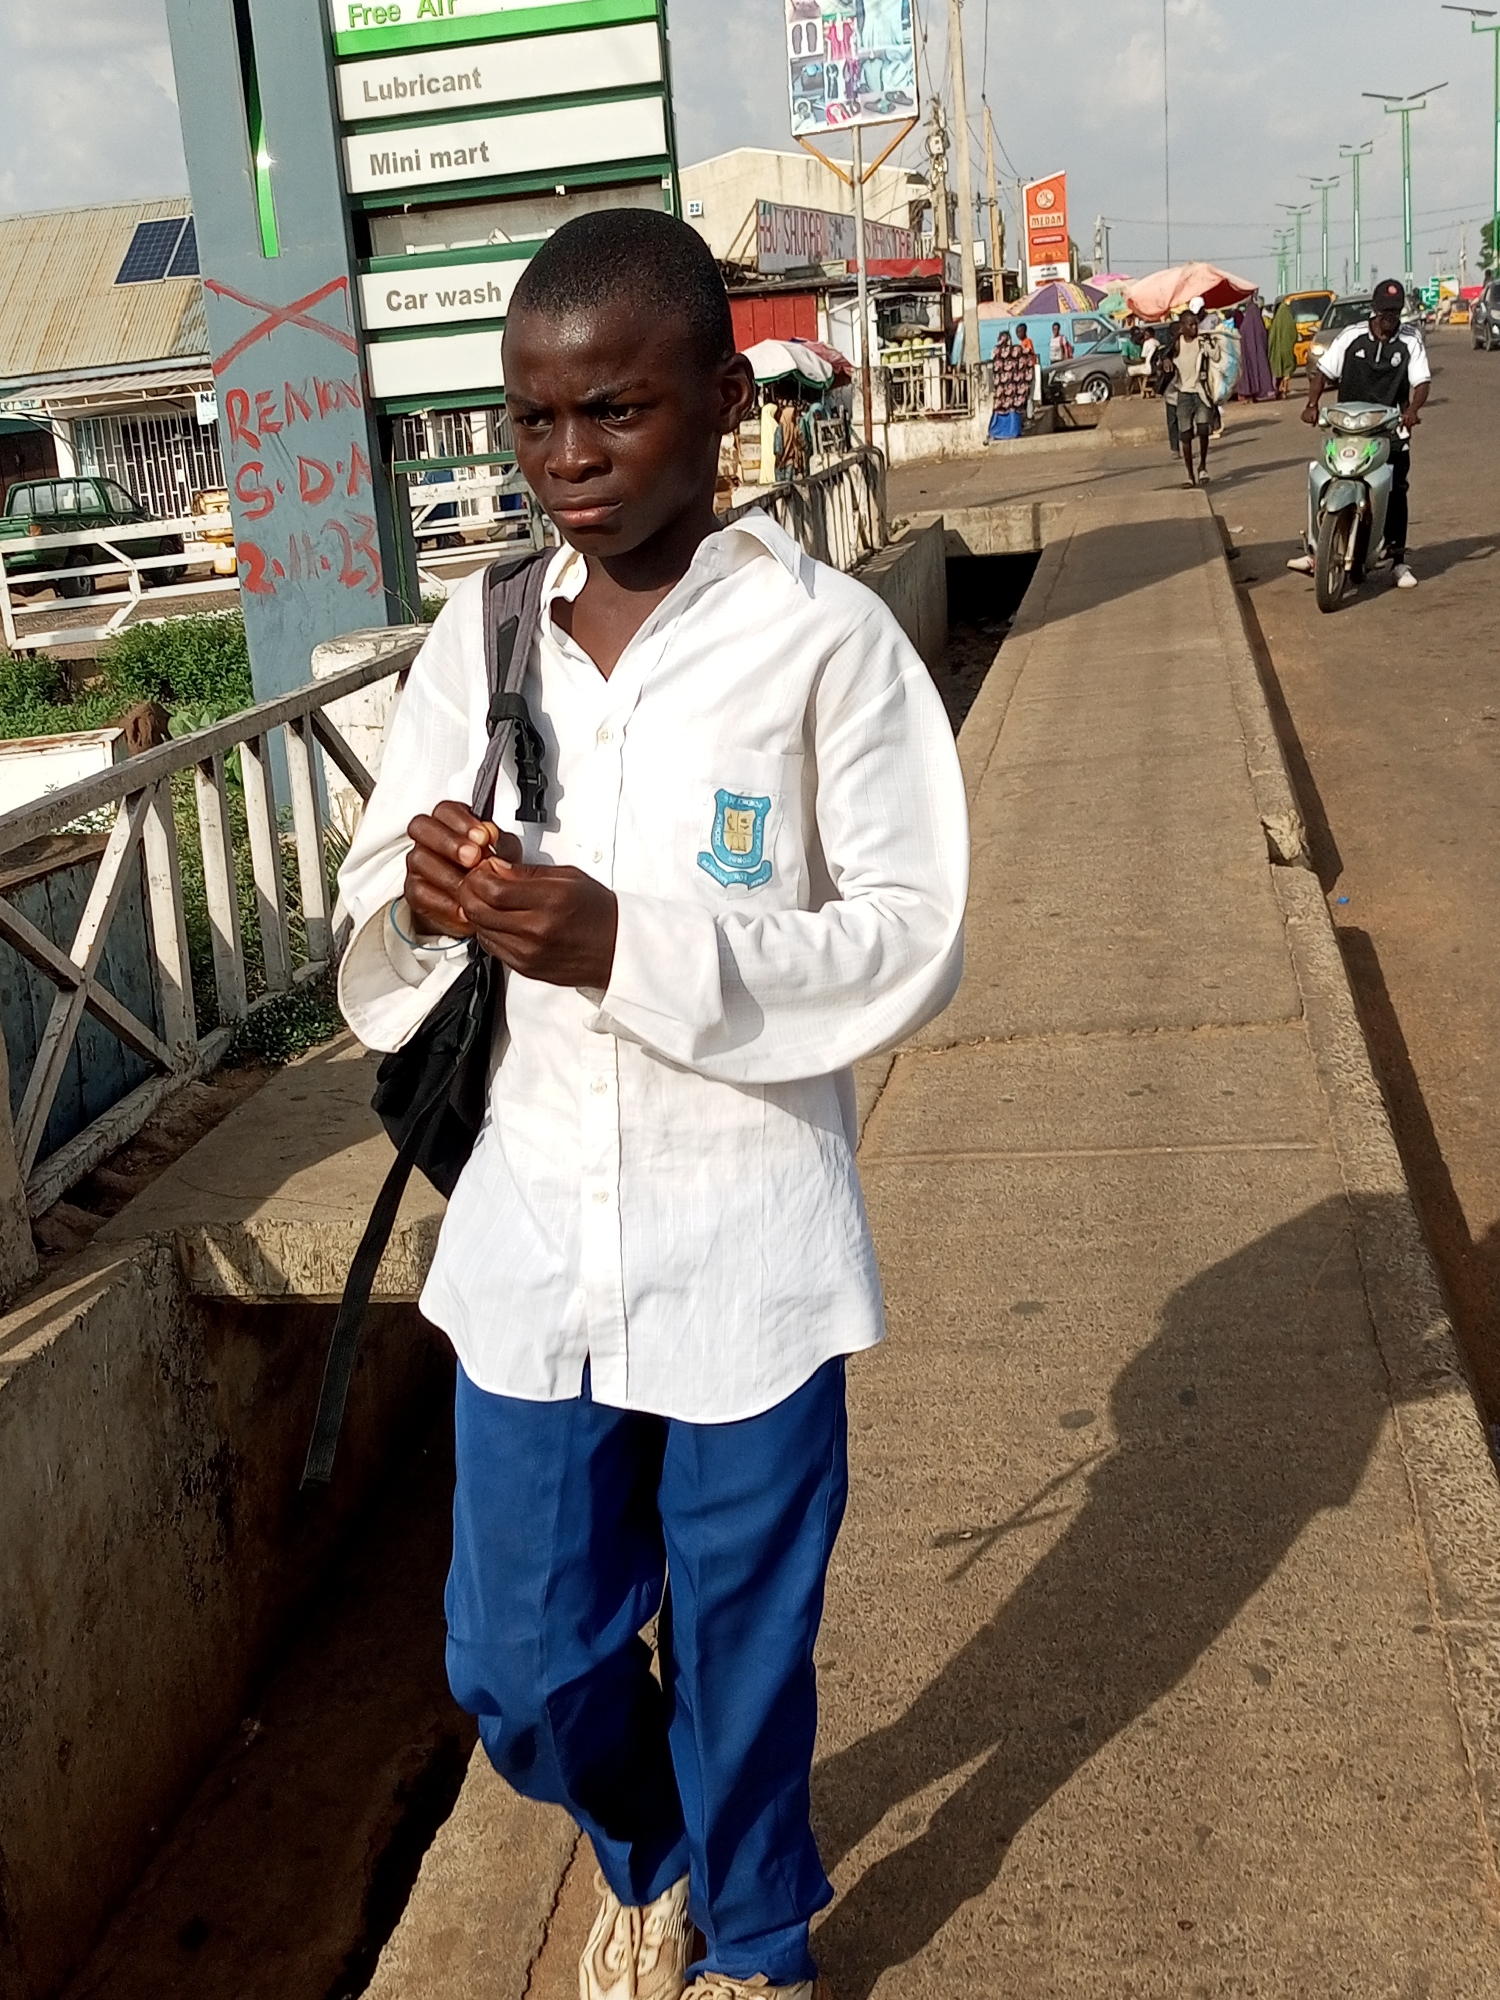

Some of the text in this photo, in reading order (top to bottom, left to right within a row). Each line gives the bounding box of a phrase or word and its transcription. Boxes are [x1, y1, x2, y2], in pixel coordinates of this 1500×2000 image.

[348, 0, 457, 28] Free Air
[363, 66, 482, 103] Lubricant
[369, 141, 490, 176] Mini mart
[1031, 214, 1062, 227] MEDAN
[386, 281, 502, 312] Car wash
